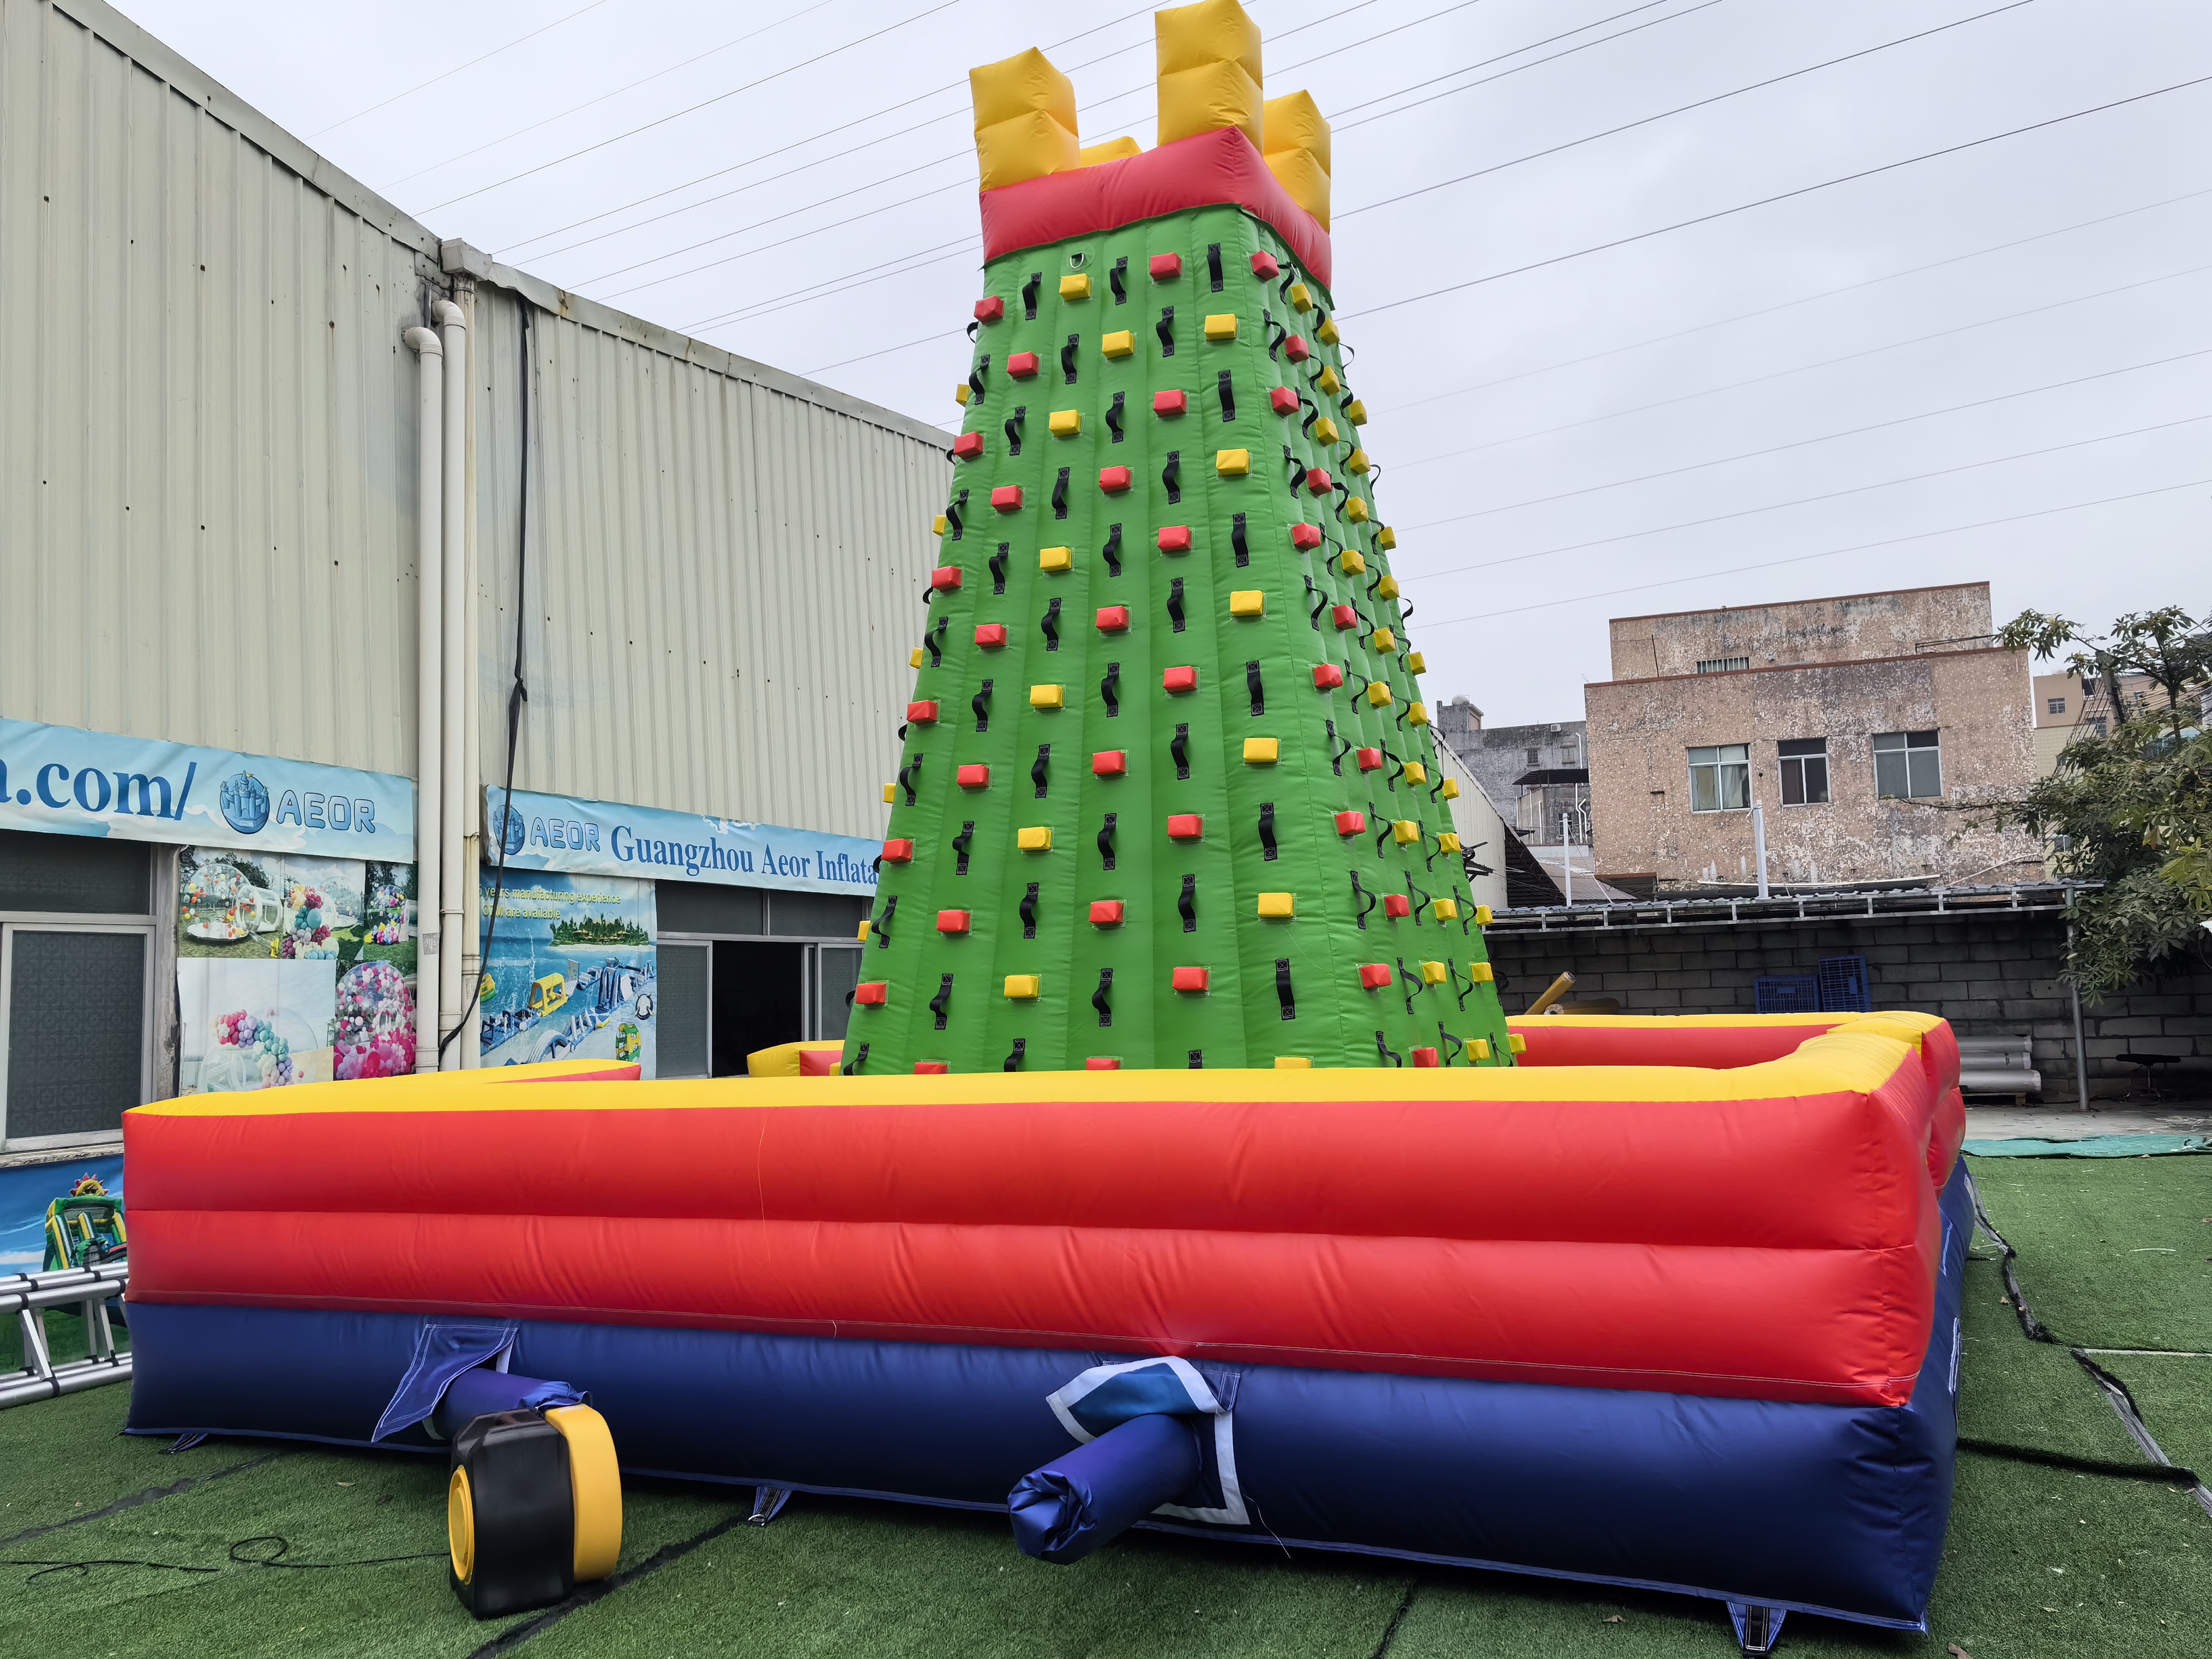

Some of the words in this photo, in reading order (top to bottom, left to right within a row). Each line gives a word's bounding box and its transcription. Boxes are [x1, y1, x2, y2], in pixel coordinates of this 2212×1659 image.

[276, 790, 375, 833] AEOR
[530, 817, 601, 852] AEOR
[611, 825, 754, 876] Guangzhou
[761, 843, 811, 878] Aeor
[485, 886, 510, 900] yers
[512, 888, 575, 905] manufacturing
[577, 893, 620, 906] experience
[506, 908, 520, 919] are
[523, 907, 561, 920] available
